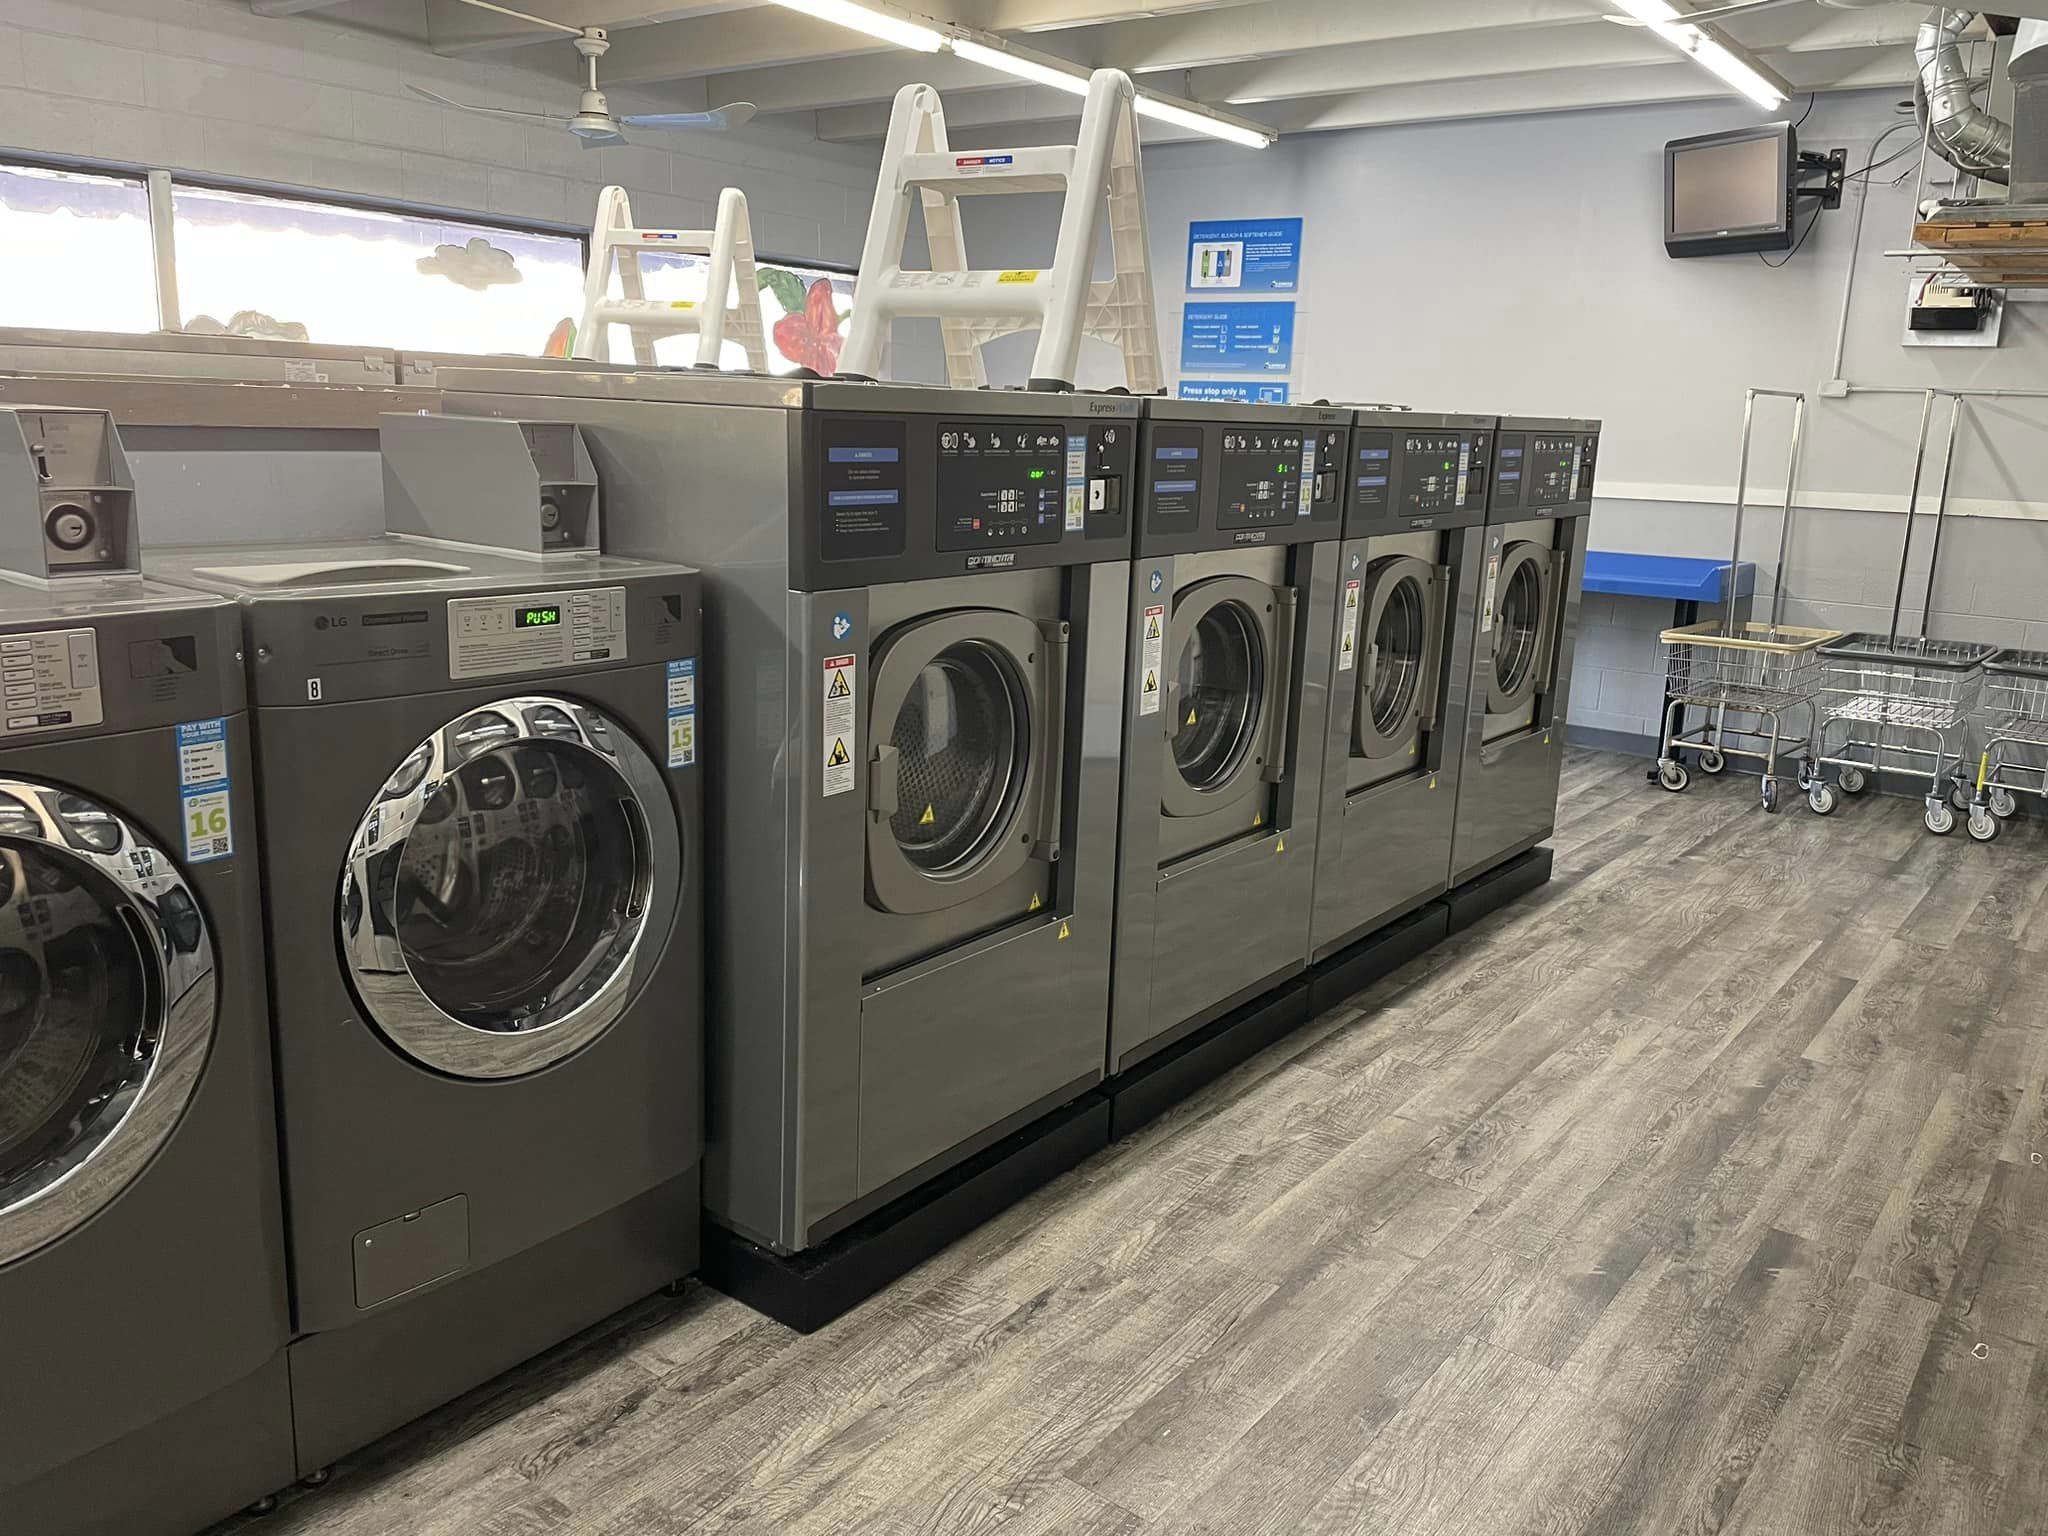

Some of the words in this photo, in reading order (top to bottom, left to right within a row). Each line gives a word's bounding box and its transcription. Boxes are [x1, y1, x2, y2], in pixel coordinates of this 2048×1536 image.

[1183, 386, 1203, 394] Press
[1204, 387, 1220, 396] stop
[1221, 387, 1237, 397] only
[1239, 387, 1247, 395] in
[1069, 495, 1082, 513] 14
[331, 616, 348, 628] LG
[526, 611, 556, 624] PUSH
[311, 681, 319, 698] 8
[181, 722, 198, 732] PAY
[199, 720, 221, 731] WITH
[671, 727, 692, 749] 15
[190, 807, 227, 838] 16
